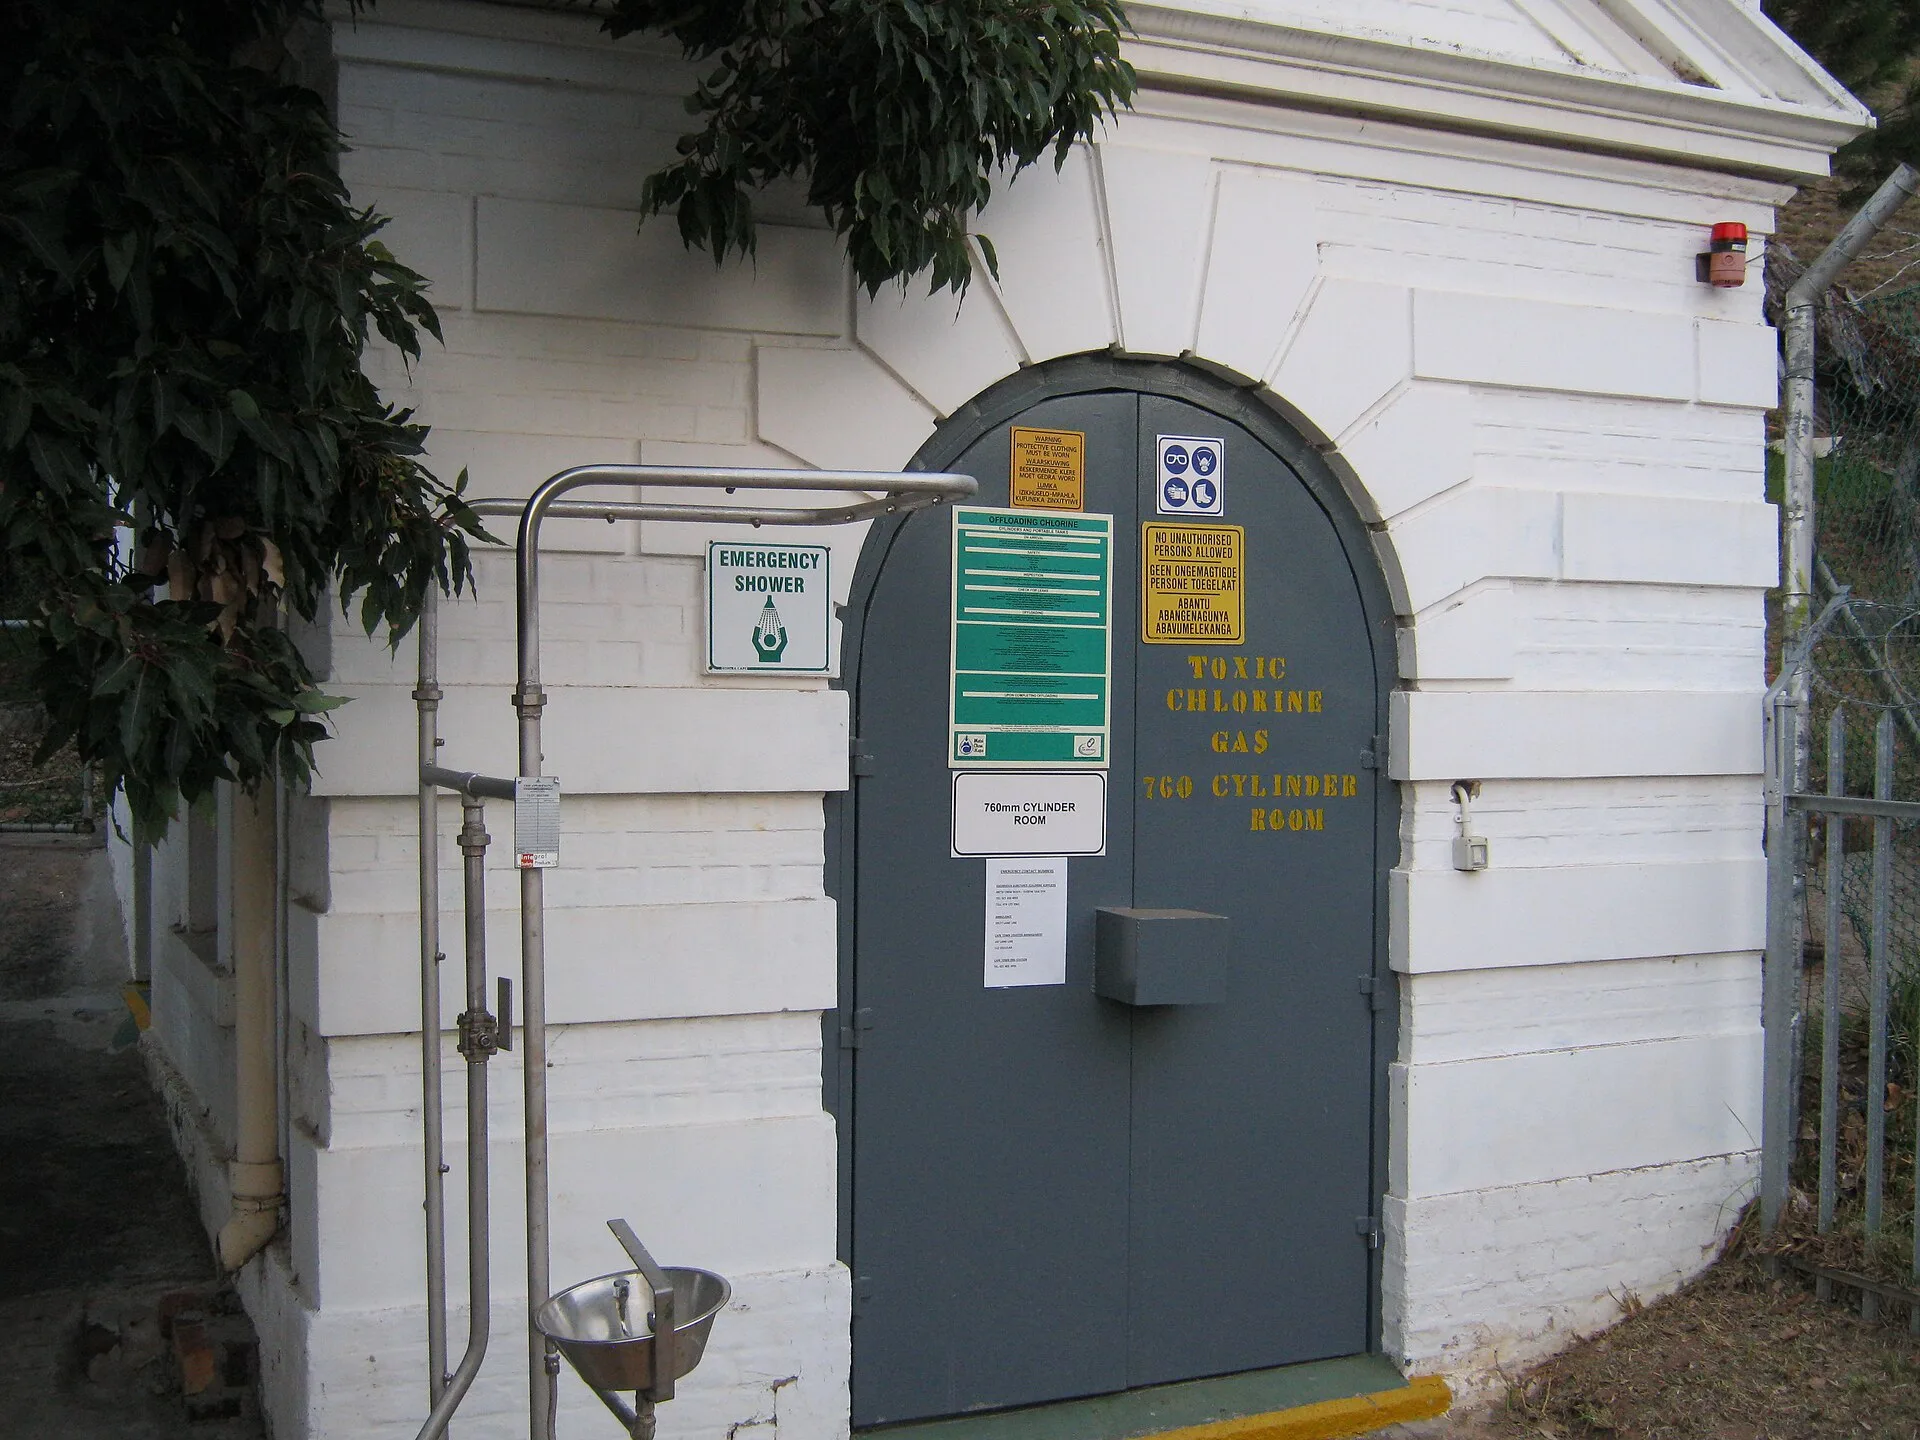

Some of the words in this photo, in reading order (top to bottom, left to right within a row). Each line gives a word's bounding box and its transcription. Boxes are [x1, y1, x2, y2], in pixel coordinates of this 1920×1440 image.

[1050, 445, 1077, 453] CLOTHING
[1026, 458, 1070, 466] WAARSKUWING
[1020, 466, 1058, 474] BESKERMENDE
[988, 516, 1038, 526] OFFLOADING
[1040, 518, 1078, 528] CHLORINE
[1156, 532, 1166, 543] NO
[1170, 533, 1232, 546] UNAUTHORISED
[1154, 545, 1192, 557] PERSONS
[1196, 547, 1232, 558] ALLOWED
[720, 550, 820, 569] EMERGENCY
[1150, 565, 1171, 576] GEEN
[1175, 566, 1237, 578] ONGEMAGTIGDE
[735, 575, 805, 593] SHOWER
[1150, 578, 1188, 589] PERSONE
[1192, 579, 1236, 591] TOEGELAAT
[1178, 598, 1210, 609] ABANTU
[1159, 610, 1229, 622] ABANGENAGUNYA
[1156, 623, 1232, 634] ABAVUMELEKANGA
[1187, 655, 1286, 680] TOXIC
[1166, 688, 1323, 713] CHLORINE
[1211, 729, 1269, 754] GAS
[1142, 775, 1193, 800] 760
[1212, 773, 1358, 798] CYLINDER
[984, 802, 1020, 812] 760mm
[1023, 803, 1075, 812] CYLINDER
[1014, 816, 1046, 825] ROOM
[1250, 808, 1325, 832] ROOM
